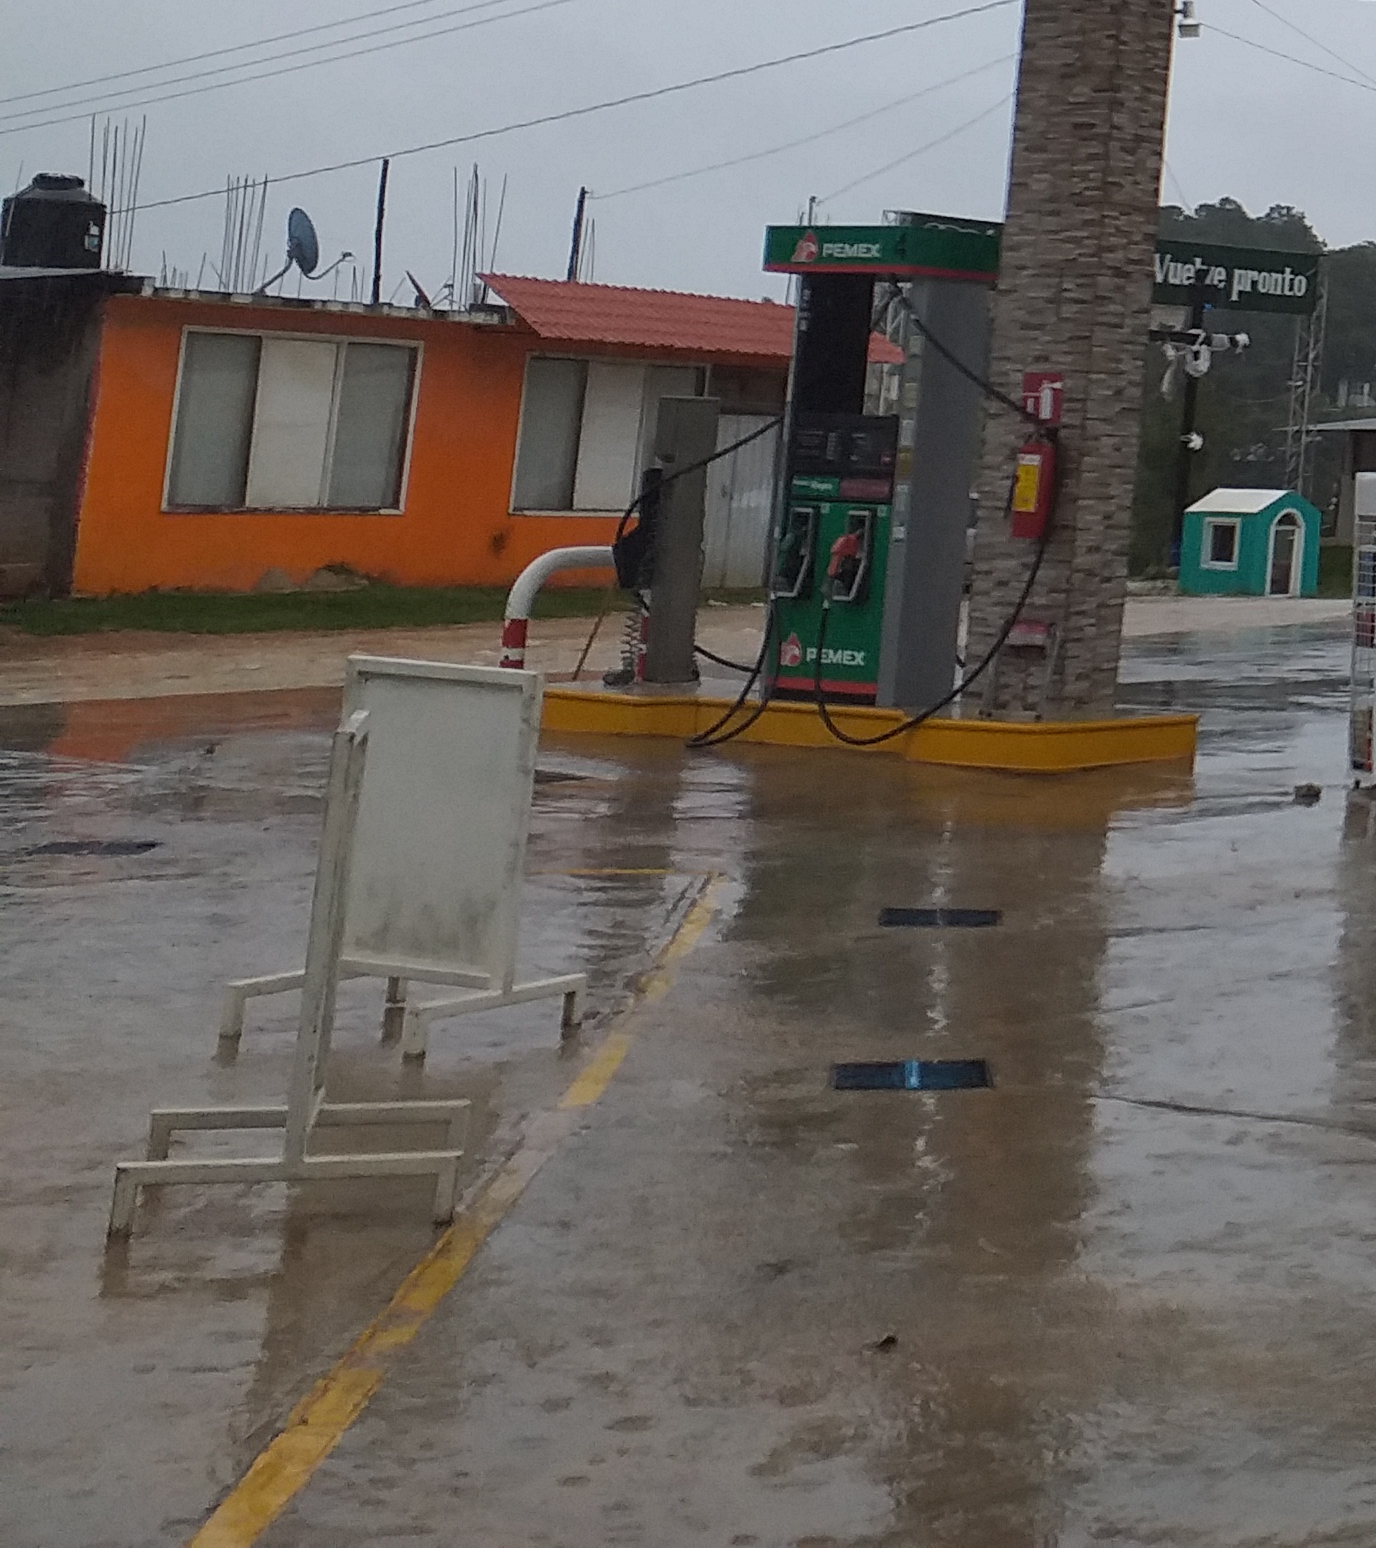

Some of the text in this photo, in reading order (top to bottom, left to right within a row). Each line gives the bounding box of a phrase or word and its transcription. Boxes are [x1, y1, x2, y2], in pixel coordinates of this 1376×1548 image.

[822, 243, 880, 258] PEMEX
[1229, 267, 1308, 301] pronto
[806, 647, 865, 666] PEMEX
